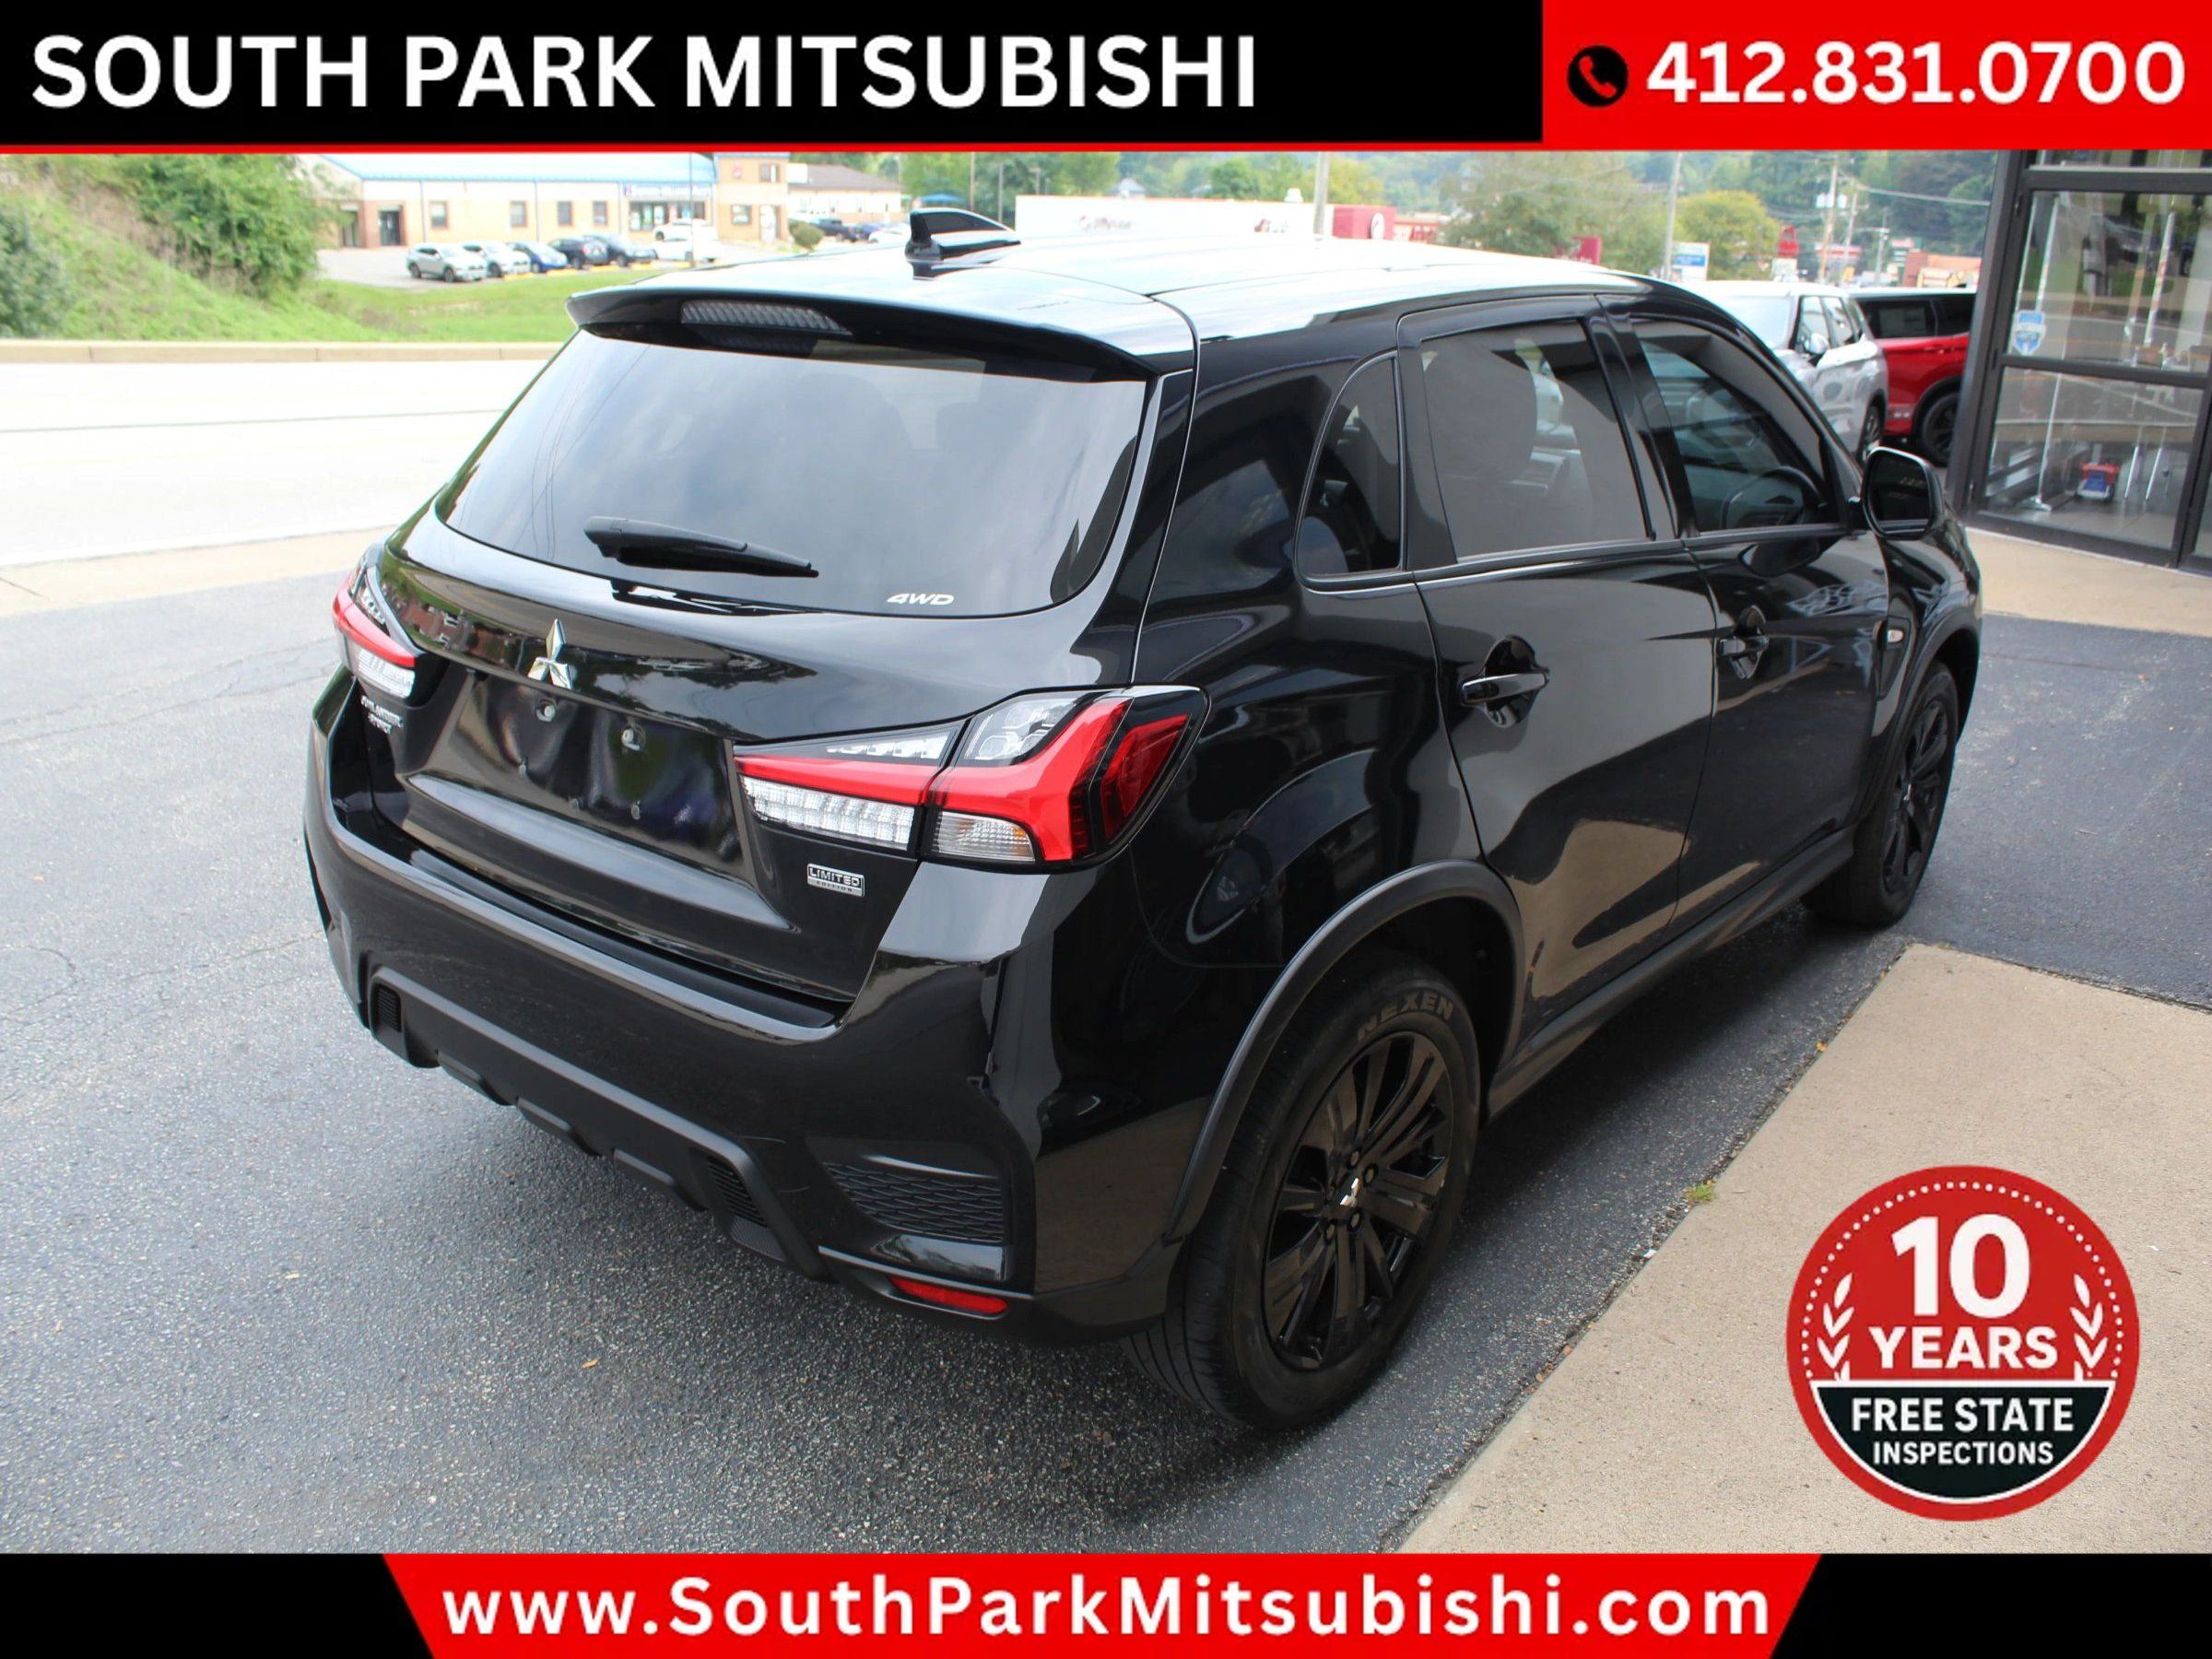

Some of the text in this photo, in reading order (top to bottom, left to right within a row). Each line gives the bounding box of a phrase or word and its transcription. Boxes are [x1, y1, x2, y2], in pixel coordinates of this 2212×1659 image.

[887, 593, 954, 606] 4WD
[809, 866, 861, 887] LIMITED
[1358, 990, 1453, 1041] NEXEN
